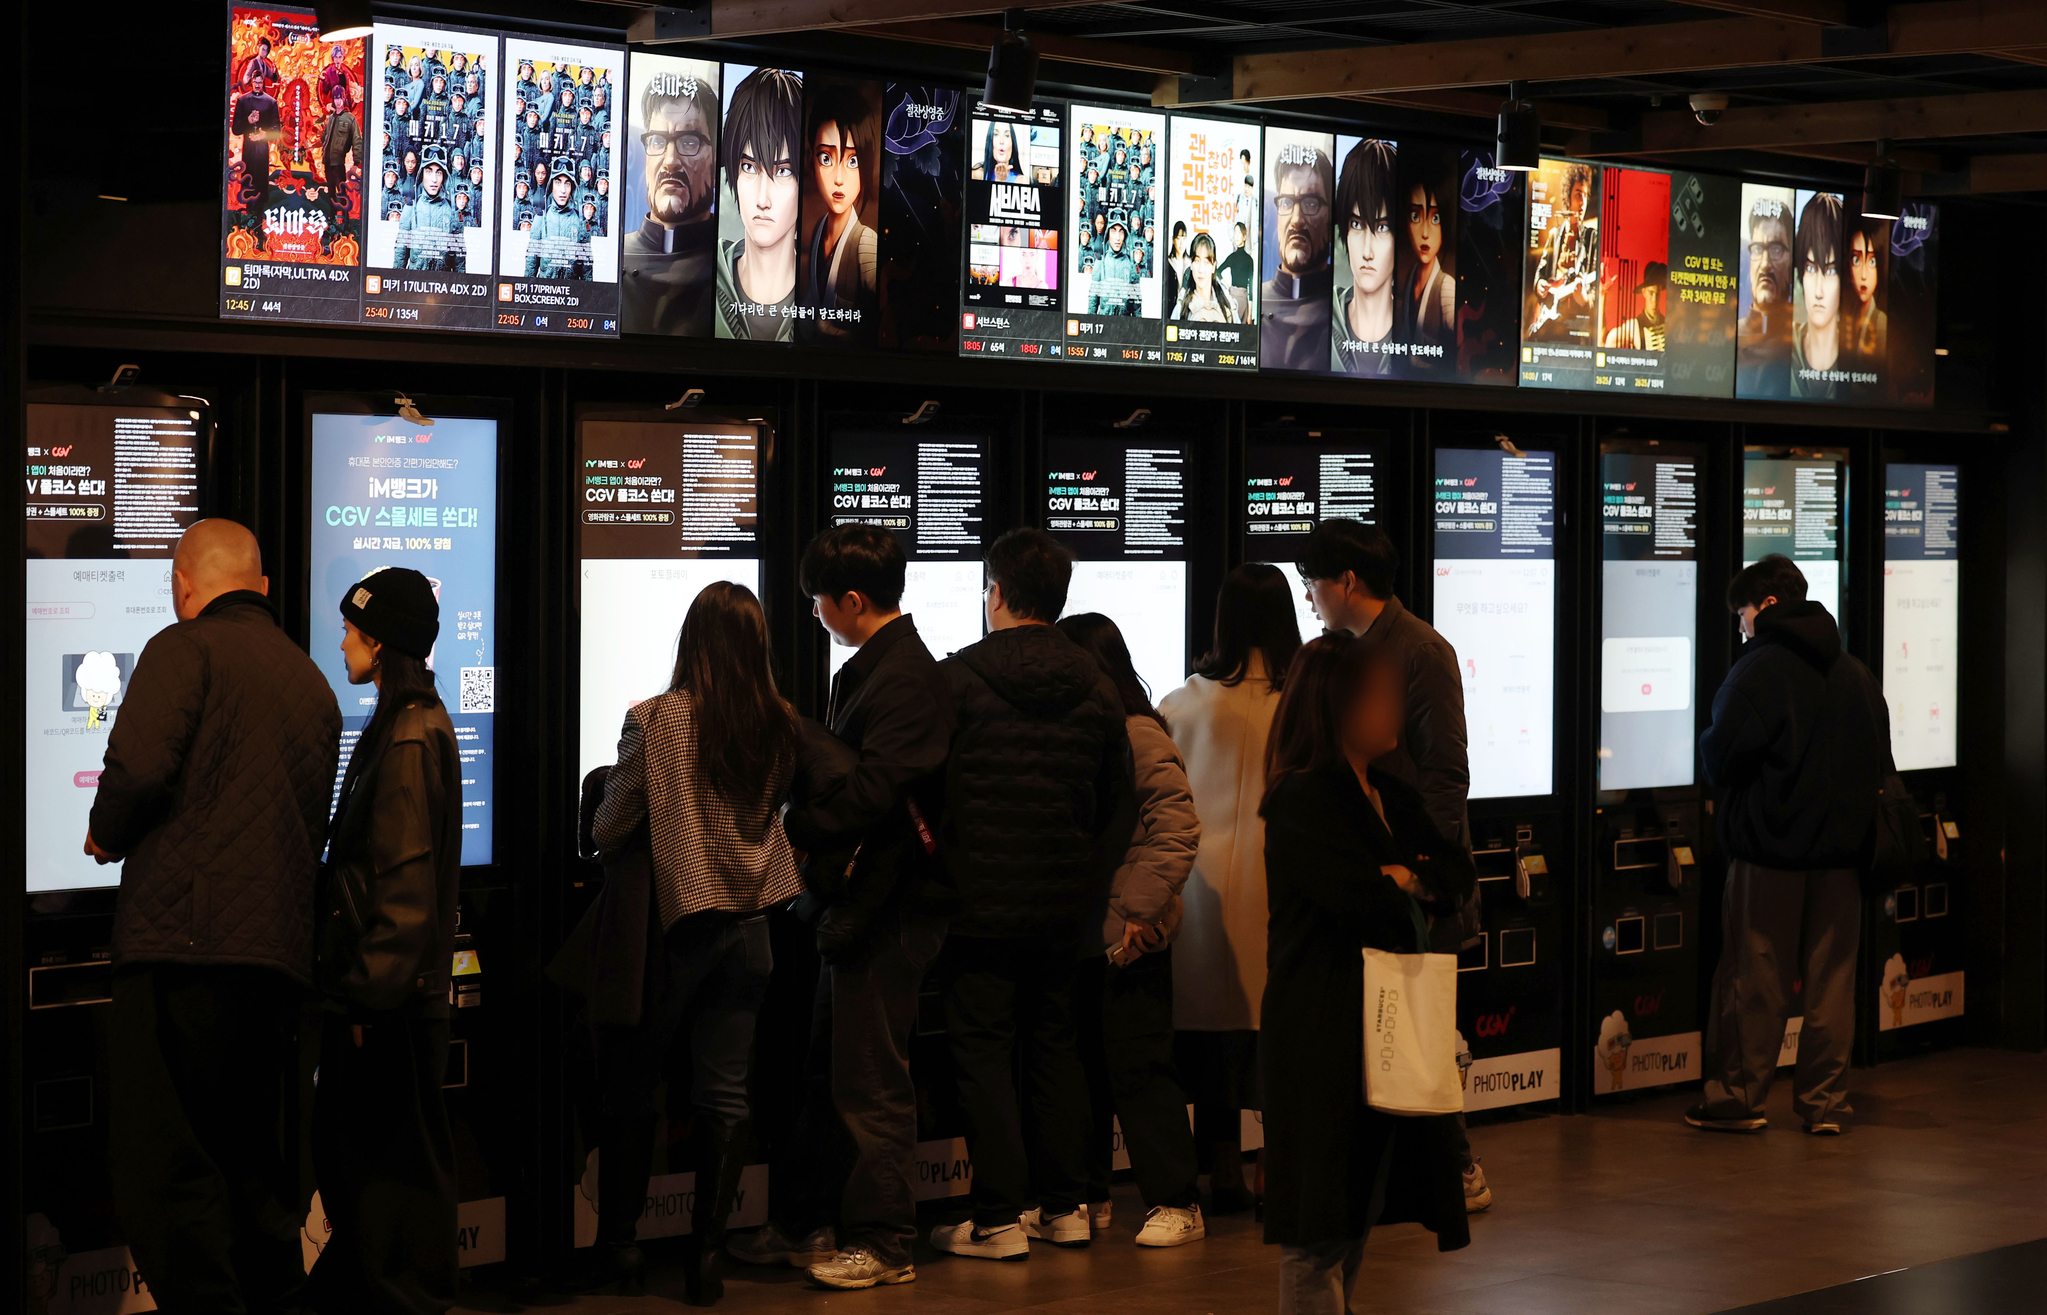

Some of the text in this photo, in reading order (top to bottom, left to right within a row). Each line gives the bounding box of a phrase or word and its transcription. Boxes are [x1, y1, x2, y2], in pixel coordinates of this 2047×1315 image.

[905, 103, 945, 121] 절찬상영중
[409, 119, 434, 138] 미키
[539, 132, 563, 150] 미키
[1188, 133, 1234, 170] 괜찮아?
[263, 206, 329, 240] 퇴마록
[1684, 255, 1702, 269] CGV
[1710, 258, 1724, 272] 또는
[329, 270, 350, 282] 4DX
[242, 278, 260, 290] 2D)
[382, 279, 400, 293] 미키
[403, 280, 448, 294] 17(ULTRA
[449, 283, 470, 295] 4DX
[471, 285, 487, 297] 2D)
[514, 283, 528, 294] 미키
[530, 284, 571, 296] 17(PRIVATE
[1729, 276, 1737, 290] 시
[514, 294, 579, 307] BOX,SCREENX 2D)
[1680, 288, 1726, 305] 주차 3시간 무료
[226, 299, 281, 313] 12:45 44석
[729, 301, 862, 323] 기다리던 큰 손님들이 당도하리라
[365, 307, 418, 320] 25:40 135석
[497, 314, 616, 331] 22:05 0석 25:00 8석
[976, 316, 1011, 329] 서브스턴스
[1079, 322, 1104, 335] 미키 17
[963, 340, 981, 351] 18:05
[990, 342, 1005, 353] 65석
[1020, 344, 1039, 354] 18:05
[1067, 346, 1085, 357] 15:55
[1122, 349, 1139, 360] 16:15
[1342, 340, 1444, 358] 기다리던 큰 손님들이 당도하리라
[1166, 352, 1183, 362] 17:05
[1218, 355, 1235, 365] 22:05
[415, 432, 433, 444] CGV
[51, 444, 73, 457] CGV
[347, 456, 459, 470] 휴대폰 본인인증 간편가입만해도?
[627, 457, 647, 469] CGV
[31, 465, 92, 477] 앱이 처음이라면?
[869, 465, 887, 477] CGV
[78, 479, 106, 496] 쏜다!
[609, 476, 623, 486] 앱이
[624, 476, 663, 486] 처음이라면?
[368, 476, 439, 500] iM뱅크가
[585, 488, 616, 502] CGV
[650, 488, 675, 503] 쏜다!
[833, 494, 860, 509] CGV
[890, 495, 912, 509] 쏜다!
[1048, 497, 1073, 511] CGV
[1247, 502, 1271, 515] CGV
[1435, 501, 1456, 514] CGV
[43, 507, 69, 517] 스몰세트
[68, 507, 86, 517] 100%
[325, 505, 478, 528] CGV 스몰세트 쏜다!
[642, 513, 658, 521] 100%
[1603, 505, 1620, 517] CGV
[352, 537, 452, 551] 실시간 지급, 100% 당첨
[73, 570, 125, 583] 예매티켓출력
[650, 569, 688, 580] 포토플레이
[1436, 565, 1453, 577] CGV
[31, 607, 70, 615] 예매번호로 조회
[125, 606, 167, 614] 휴대폰번호로 조회
[1456, 602, 1479, 615] 무엇을
[457, 611, 473, 621] 실시간
[467, 621, 483, 631] 싶다면
[457, 632, 467, 640] QR
[1909, 990, 1953, 1010] PHOTOPLAY
[1376, 988, 1386, 1033] STARBUCKS
[1475, 1005, 1516, 1038] CGV
[1632, 1051, 1688, 1073] PHOTOPLAY
[1473, 1070, 1544, 1094] PHOTOPLAY
